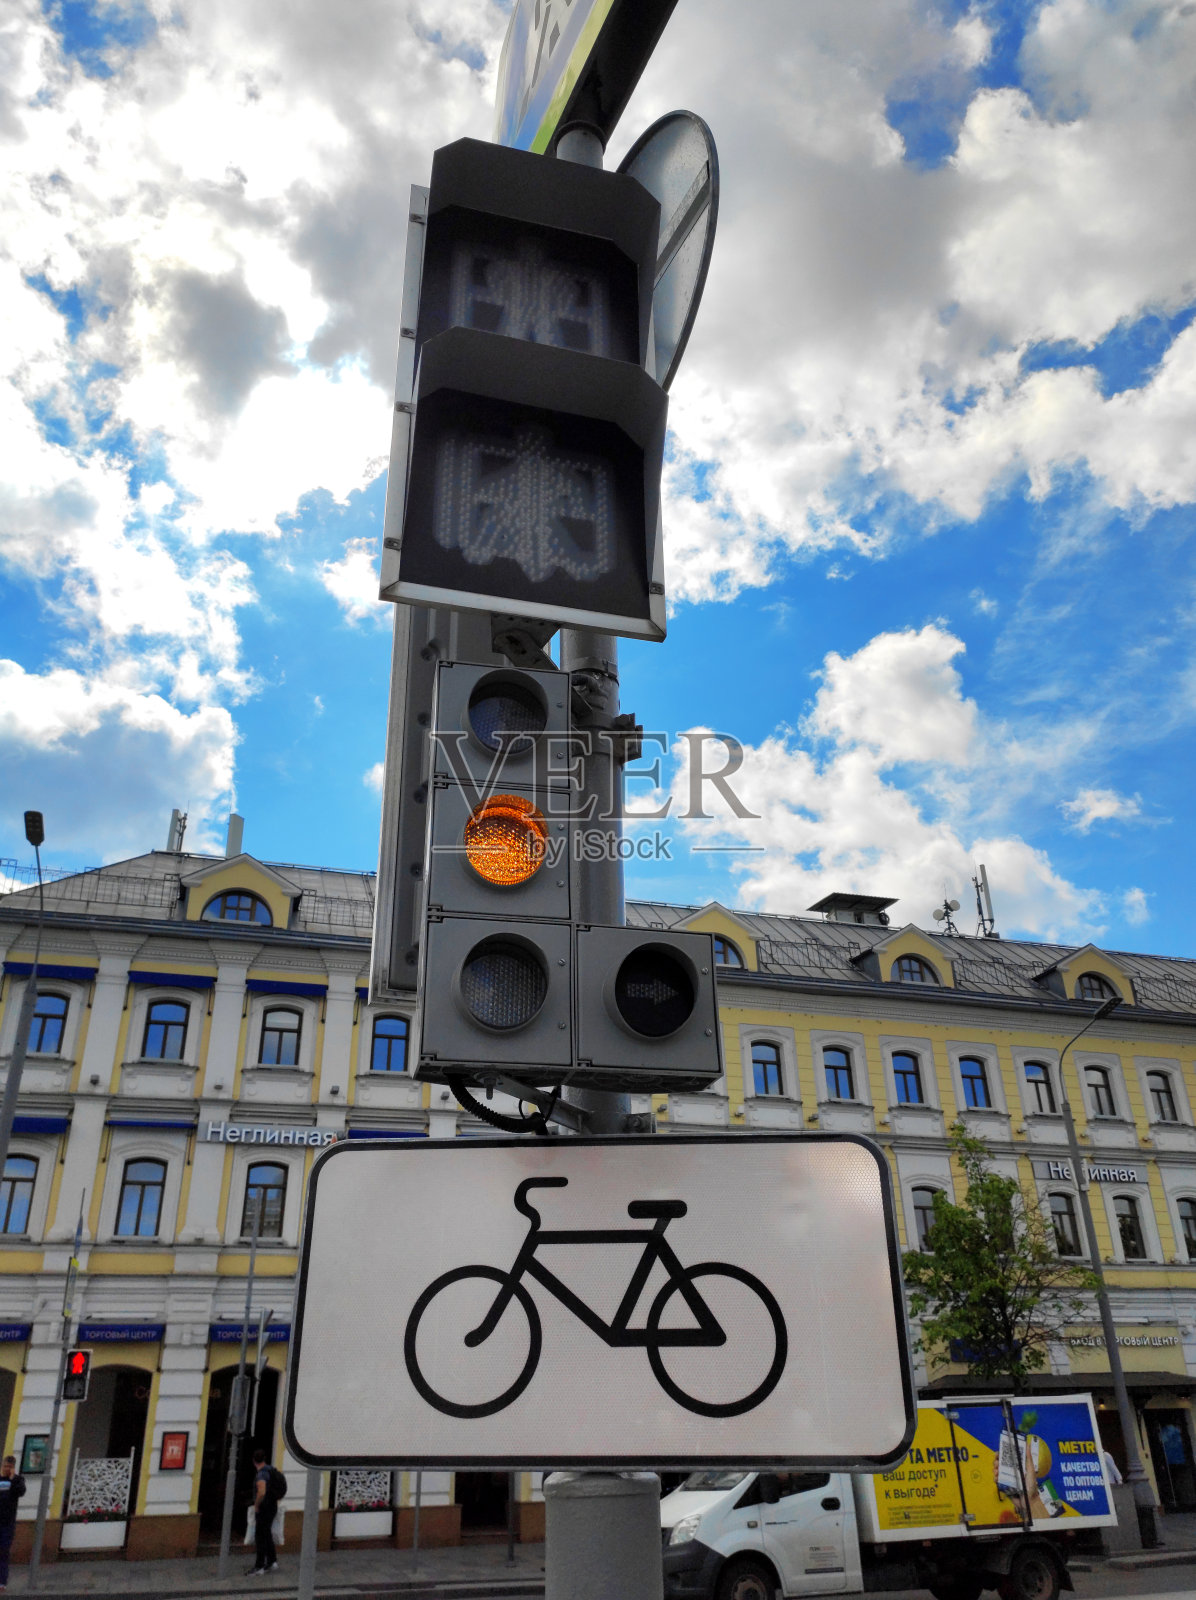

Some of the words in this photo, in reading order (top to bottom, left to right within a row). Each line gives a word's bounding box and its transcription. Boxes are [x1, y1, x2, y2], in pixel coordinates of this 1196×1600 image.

[206, 1121, 334, 1146] Неглинная
[1049, 1161, 1137, 1182] Неинная
[0, 1330, 21, 1339] ЕНТР
[85, 1329, 129, 1339] ТОРГОВЫЙ
[131, 1330, 157, 1340] ЦЕНТР
[1103, 1335, 1150, 1346] ТРГОВЫЙ
[1152, 1336, 1179, 1347] ЦЕНТР
[1058, 1441, 1096, 1454] METR
[1060, 1461, 1100, 1473] КАЧЕСТВО
[908, 1469, 947, 1482] доступ
[1063, 1476, 1075, 1487] ПО
[885, 1489, 891, 1499] к
[1066, 1490, 1094, 1502] ЦЕНАМ
